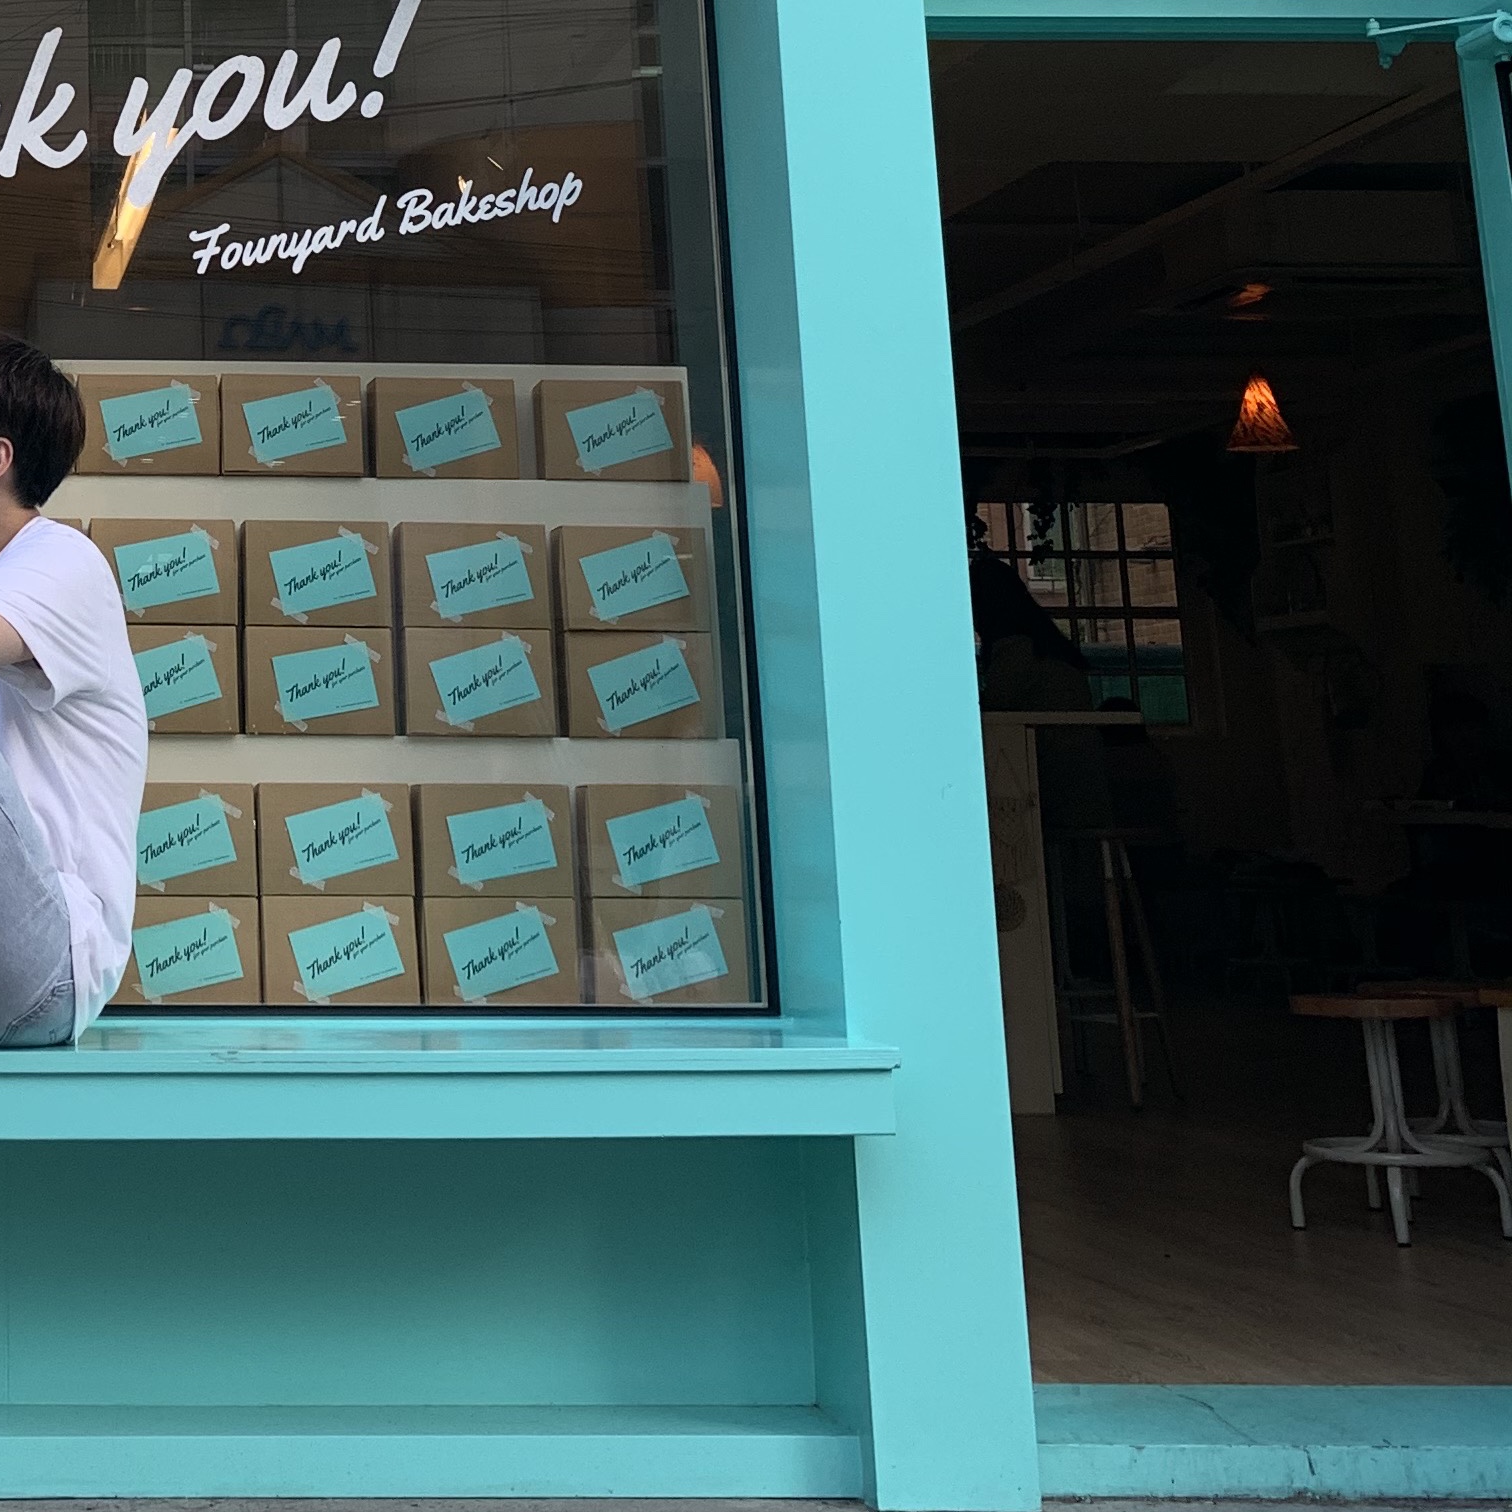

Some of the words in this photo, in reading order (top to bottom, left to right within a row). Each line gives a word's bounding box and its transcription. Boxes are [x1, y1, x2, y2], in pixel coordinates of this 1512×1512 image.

[188, 195, 388, 275] Founyard
[396, 168, 583, 235] Bakeshop
[113, 416, 147, 442] Thank
[148, 400, 170, 428] you!
[257, 417, 291, 443] Thank
[291, 401, 313, 429] you!
[411, 423, 444, 451] Thank
[445, 405, 465, 436] you!
[582, 424, 615, 452] Thank
[616, 407, 637, 436] you!
[127, 564, 162, 591] Thank
[164, 547, 186, 577] you!
[284, 567, 319, 595] Thank
[320, 550, 342, 581] you!
[440, 570, 476, 598] Thank
[476, 553, 499, 583] you!
[596, 570, 630, 600] Thank
[631, 552, 652, 583] you!
[143, 672, 163, 696] ank
[164, 654, 186, 683] you!
[285, 674, 321, 702] Thank
[322, 658, 345, 688] you!
[447, 675, 482, 705] Thank
[482, 655, 504, 687] you!
[606, 679, 639, 710] Thank
[640, 658, 661, 691] you!
[140, 833, 176, 864] Thank
[177, 813, 200, 846] you!
[302, 831, 338, 862] Thank
[338, 812, 361, 846] you!
[461, 834, 498, 864] Thank
[499, 816, 522, 849] you!
[622, 835, 658, 865] Thank
[659, 816, 682, 848] you!
[146, 946, 183, 977] Thank
[184, 928, 208, 961] you!
[306, 947, 342, 979] Thank
[343, 926, 366, 960] you!
[462, 947, 497, 980] Thank
[498, 926, 520, 961] you!
[630, 946, 666, 978] Thank
[667, 926, 690, 960] you!
